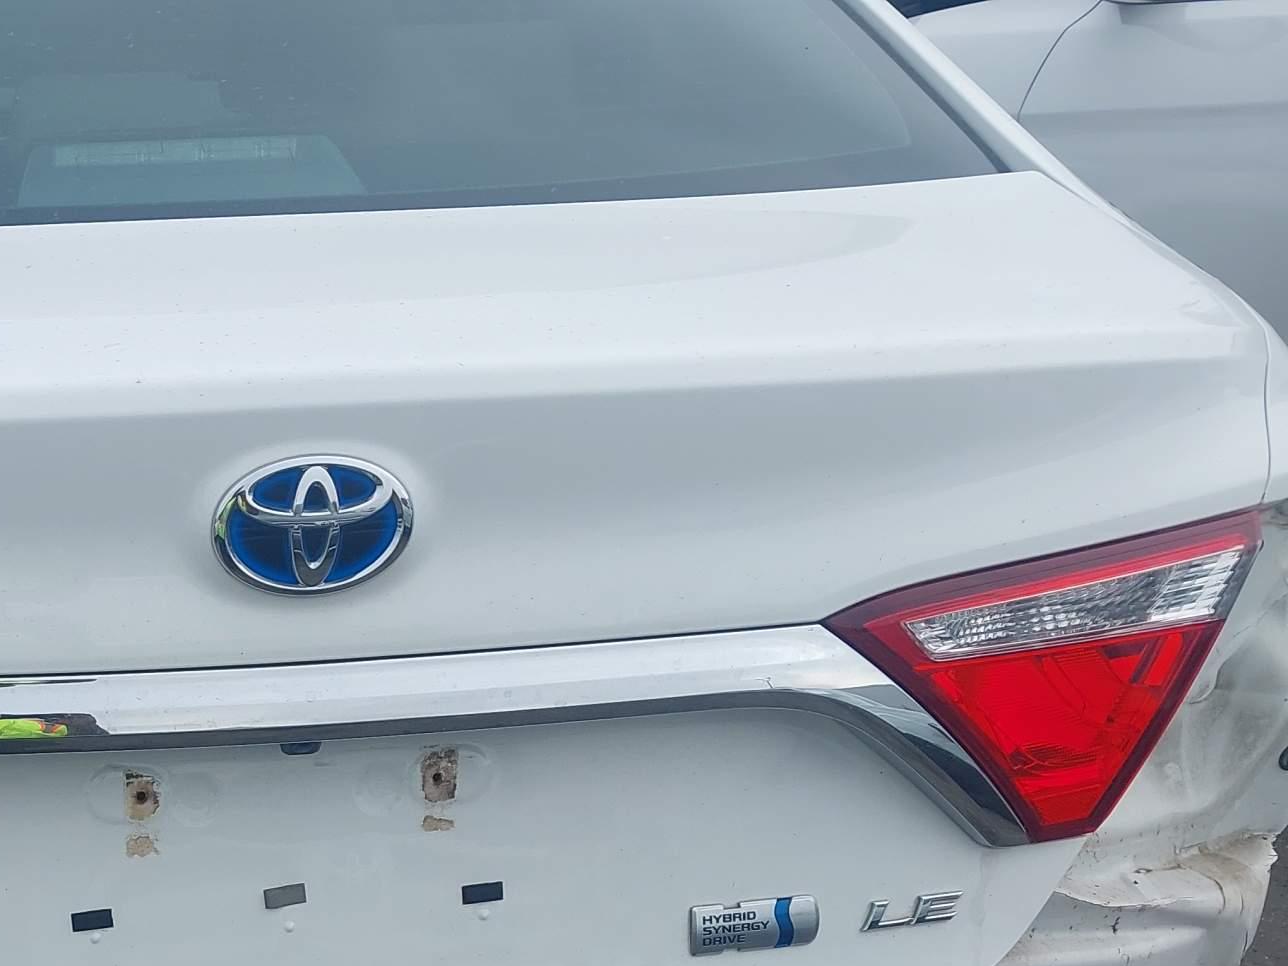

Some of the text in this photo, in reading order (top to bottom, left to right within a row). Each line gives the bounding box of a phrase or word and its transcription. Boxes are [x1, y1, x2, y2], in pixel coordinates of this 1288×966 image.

[702, 911, 757, 925] HYBRID
[860, 889, 964, 932] LE
[702, 920, 770, 936] SYNERGY
[702, 934, 746, 947] DRIVE
